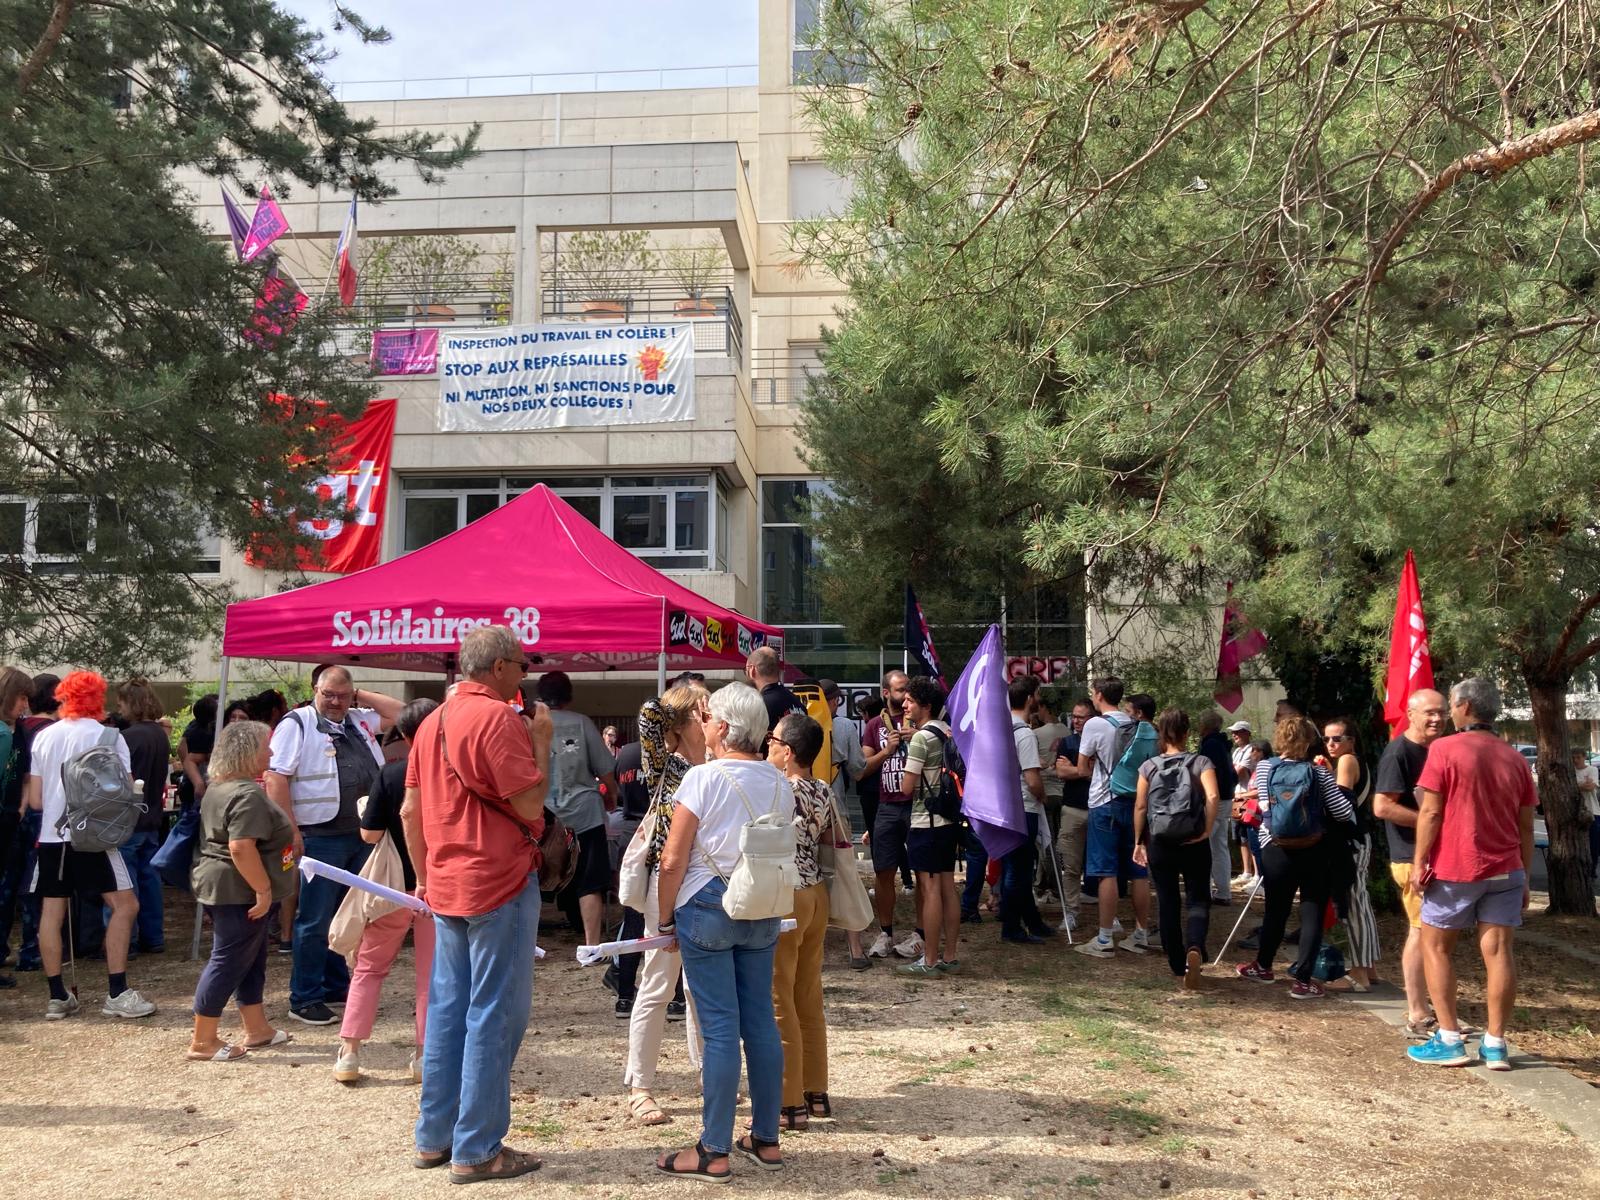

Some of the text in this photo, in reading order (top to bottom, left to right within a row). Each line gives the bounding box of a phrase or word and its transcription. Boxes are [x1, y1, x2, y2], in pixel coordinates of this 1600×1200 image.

[448, 325, 676, 350] INSPECTION DU TRAVAIL EN COLÈRE !
[445, 363, 482, 377] STOP
[488, 360, 519, 375] AUX
[524, 352, 628, 370] REPRÉSAILLES
[446, 380, 676, 403] NI MUTATION, NI SANCTIONS POUR
[482, 401, 510, 414] NOS
[512, 398, 547, 411] DEUX
[628, 399, 633, 410] !
[503, 607, 541, 645] 38
